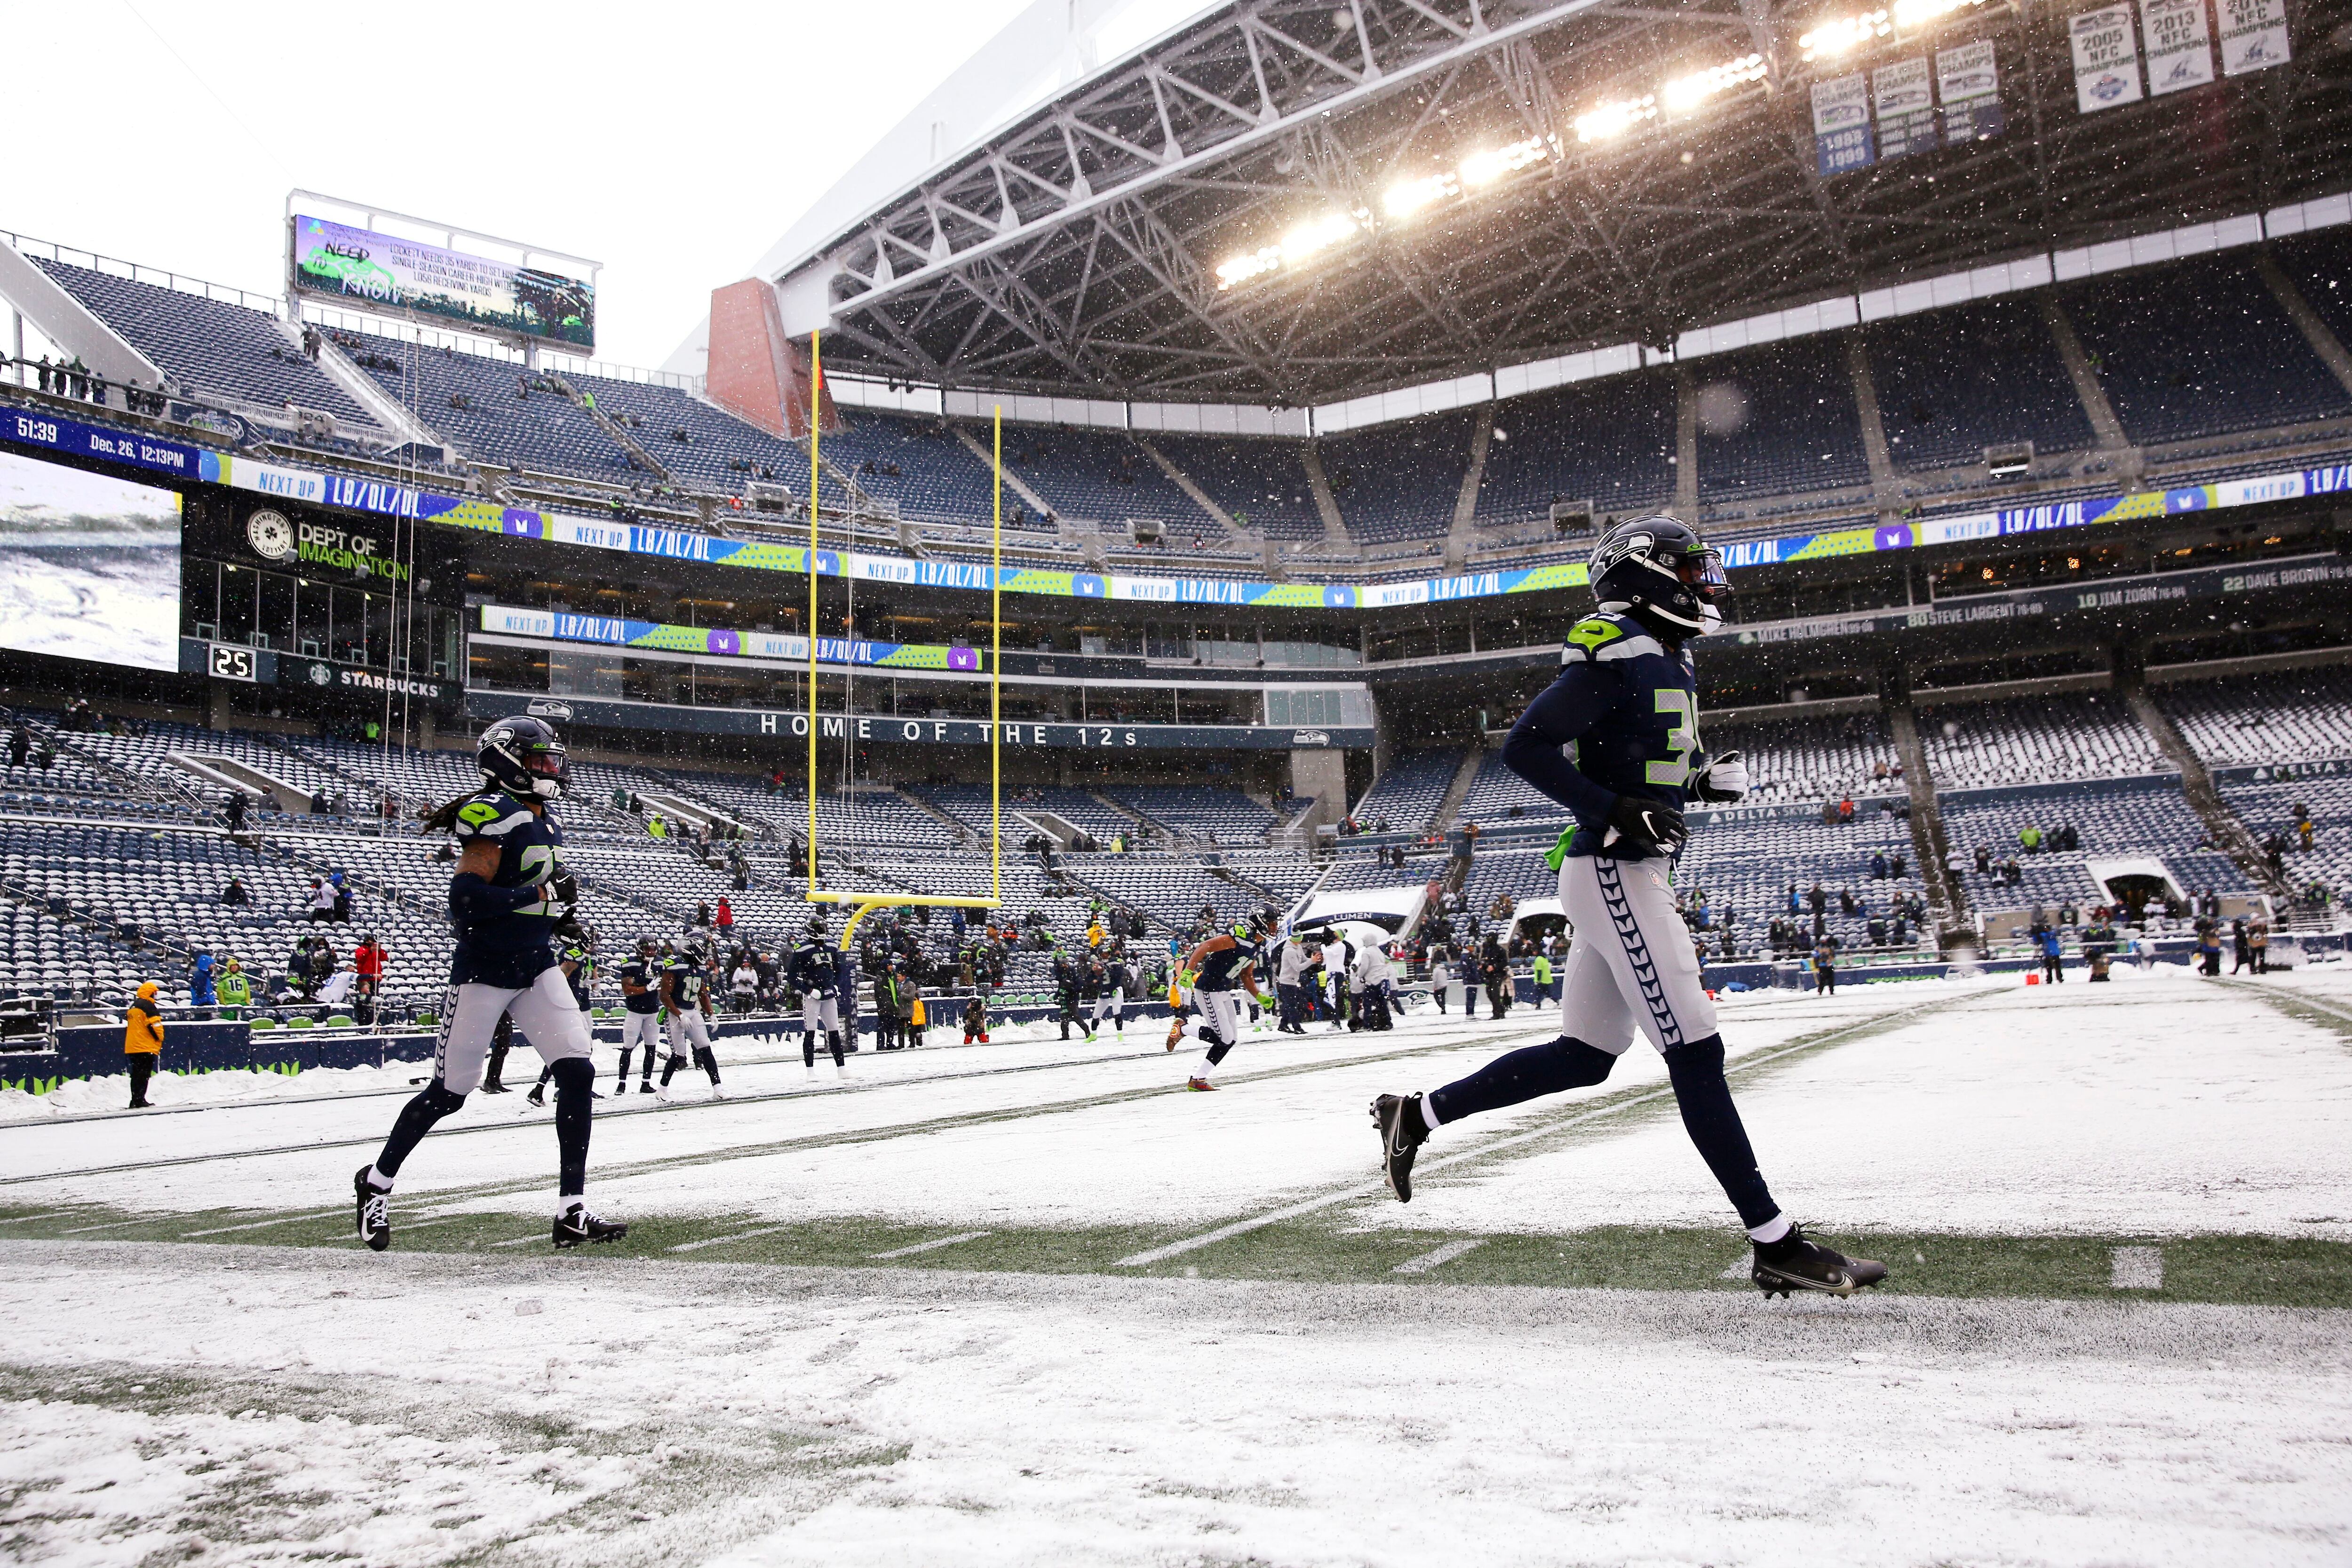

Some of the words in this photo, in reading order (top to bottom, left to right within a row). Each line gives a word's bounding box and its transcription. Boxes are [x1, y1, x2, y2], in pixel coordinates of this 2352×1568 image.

[2152, 10, 2195, 34] 2013
[2234, 7, 2268, 26] NFC
[2161, 28, 2192, 46] NFC
[2222, 16, 2284, 41] CHAMPIONS
[2082, 29, 2123, 51] 2005
[2146, 37, 2208, 60] CHAMPIONS
[1939, 55, 1992, 75] CHAMPS
[2076, 54, 2135, 78] CHAMPIONS
[2090, 47, 2118, 63] NFC
[1826, 146, 1866, 169] 1999
[326, 238, 369, 263] NEED
[390, 243, 420, 258] LOCKETT
[422, 250, 444, 264] NEEDS
[445, 256, 454, 267] 35
[456, 257, 478, 271] YARDS
[480, 263, 488, 273] TO
[490, 265, 501, 276] SET
[502, 269, 514, 279] HIS
[392, 255, 447, 276] SINGLE-SEASON
[494, 279, 512, 291] WITH
[342, 271, 400, 304] KNOW
[433, 275, 469, 292] RECEIVING
[470, 285, 492, 297] YARDS
[17, 416, 57, 444] 51:39
[89, 434, 116, 454] Dec.
[119, 440, 136, 460] 26,
[141, 444, 184, 468] 12:13PM
[259, 472, 293, 495] NEXT
[298, 479, 316, 498] UP
[2243, 484, 2273, 501] NEXT
[2280, 481, 2295, 496] UP
[299, 521, 348, 549] DEPT
[351, 534, 377, 557] OF
[577, 526, 604, 545] NEXT
[610, 532, 623, 548] UP
[1945, 523, 1972, 540] NEXT
[1977, 520, 1992, 535] UP
[298, 541, 409, 582] IMAGINATION
[868, 563, 892, 580] NEXT
[897, 566, 908, 581] UP
[2223, 576, 2245, 592] 22
[2245, 572, 2278, 590] DAVE
[2280, 566, 2329, 586] BROWN
[1131, 584, 1154, 598] NEXT
[1159, 586, 1169, 599] UP
[1383, 589, 1405, 604] NEXT
[1411, 588, 1422, 601] UP
[2077, 593, 2097, 609] 10
[2098, 590, 2123, 606] JIM
[2124, 587, 2157, 605] ZORN
[505, 616, 531, 632] NEXT
[535, 619, 548, 633] UP
[1907, 613, 1929, 628] 80
[1929, 610, 1963, 626] STEVE
[1965, 602, 2014, 622] LARGENT
[1757, 628, 1787, 643] MIKE
[765, 641, 788, 654] NEXT
[792, 644, 803, 656] UP
[216, 648, 248, 677] 25
[341, 670, 439, 699] STARBUCKS
[760, 714, 871, 739] HOME
[903, 721, 947, 741] OF
[979, 724, 1046, 744] THE
[1078, 726, 1136, 746] 12s
[1725, 808, 1776, 822] DELTA
[1334, 912, 1372, 921] LUMEN
[228, 979, 243, 992] 16
[849, 968, 858, 1046] SEAHAWKS
